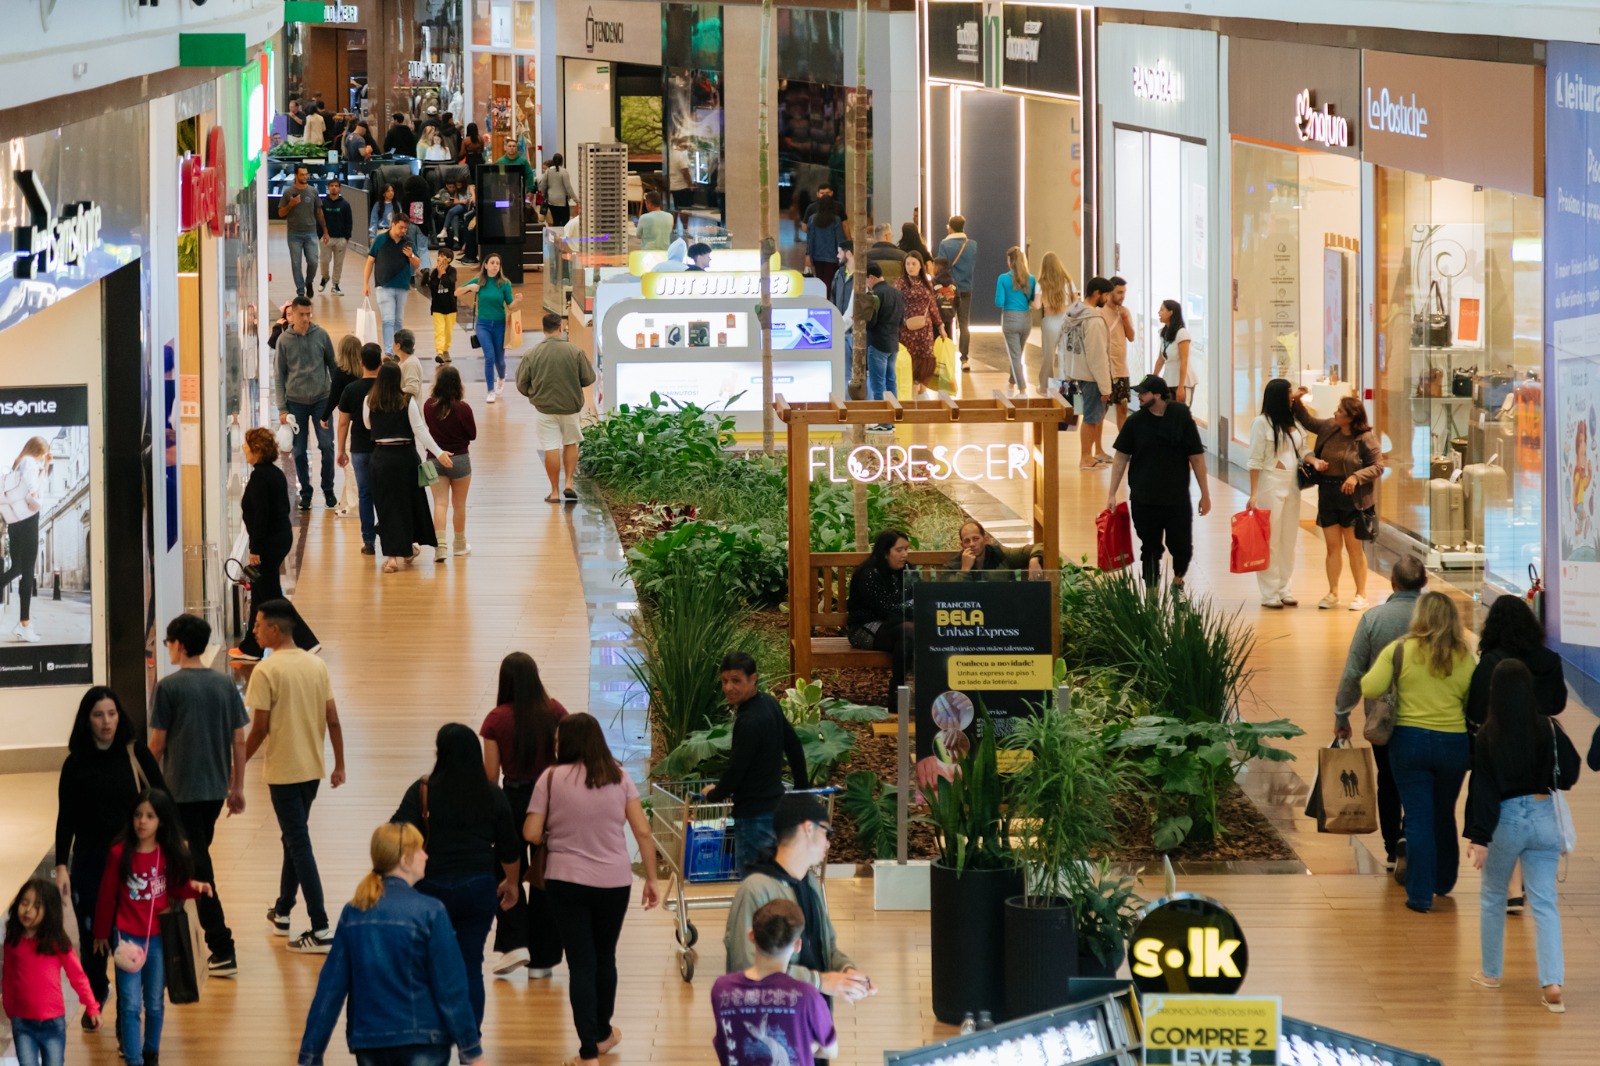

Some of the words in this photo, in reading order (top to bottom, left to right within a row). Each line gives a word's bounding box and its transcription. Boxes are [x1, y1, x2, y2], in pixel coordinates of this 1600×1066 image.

[1310, 102, 1348, 147] natura
[1586, 202, 1600, 224] praç
[808, 444, 1030, 483] FLORESCER
[936, 601, 982, 609] TRANCISTA
[936, 609, 984, 626] BELA
[937, 626, 974, 637] Unhas
[976, 626, 1020, 638] Express
[956, 660, 989, 668] Conheça
[1016, 670, 1029, 678] piso
[1157, 1007, 1208, 1017] PROMOÇÃO
[1209, 1006, 1226, 1016] MÊS
[1227, 1008, 1246, 1016] DOS
[1247, 1008, 1266, 1017] PAIS
[1150, 1027, 1249, 1046] COMPRE
[1254, 1028, 1267, 1046] 2
[1171, 1048, 1232, 1066] LEVE
[1238, 1048, 1252, 1066] 3
